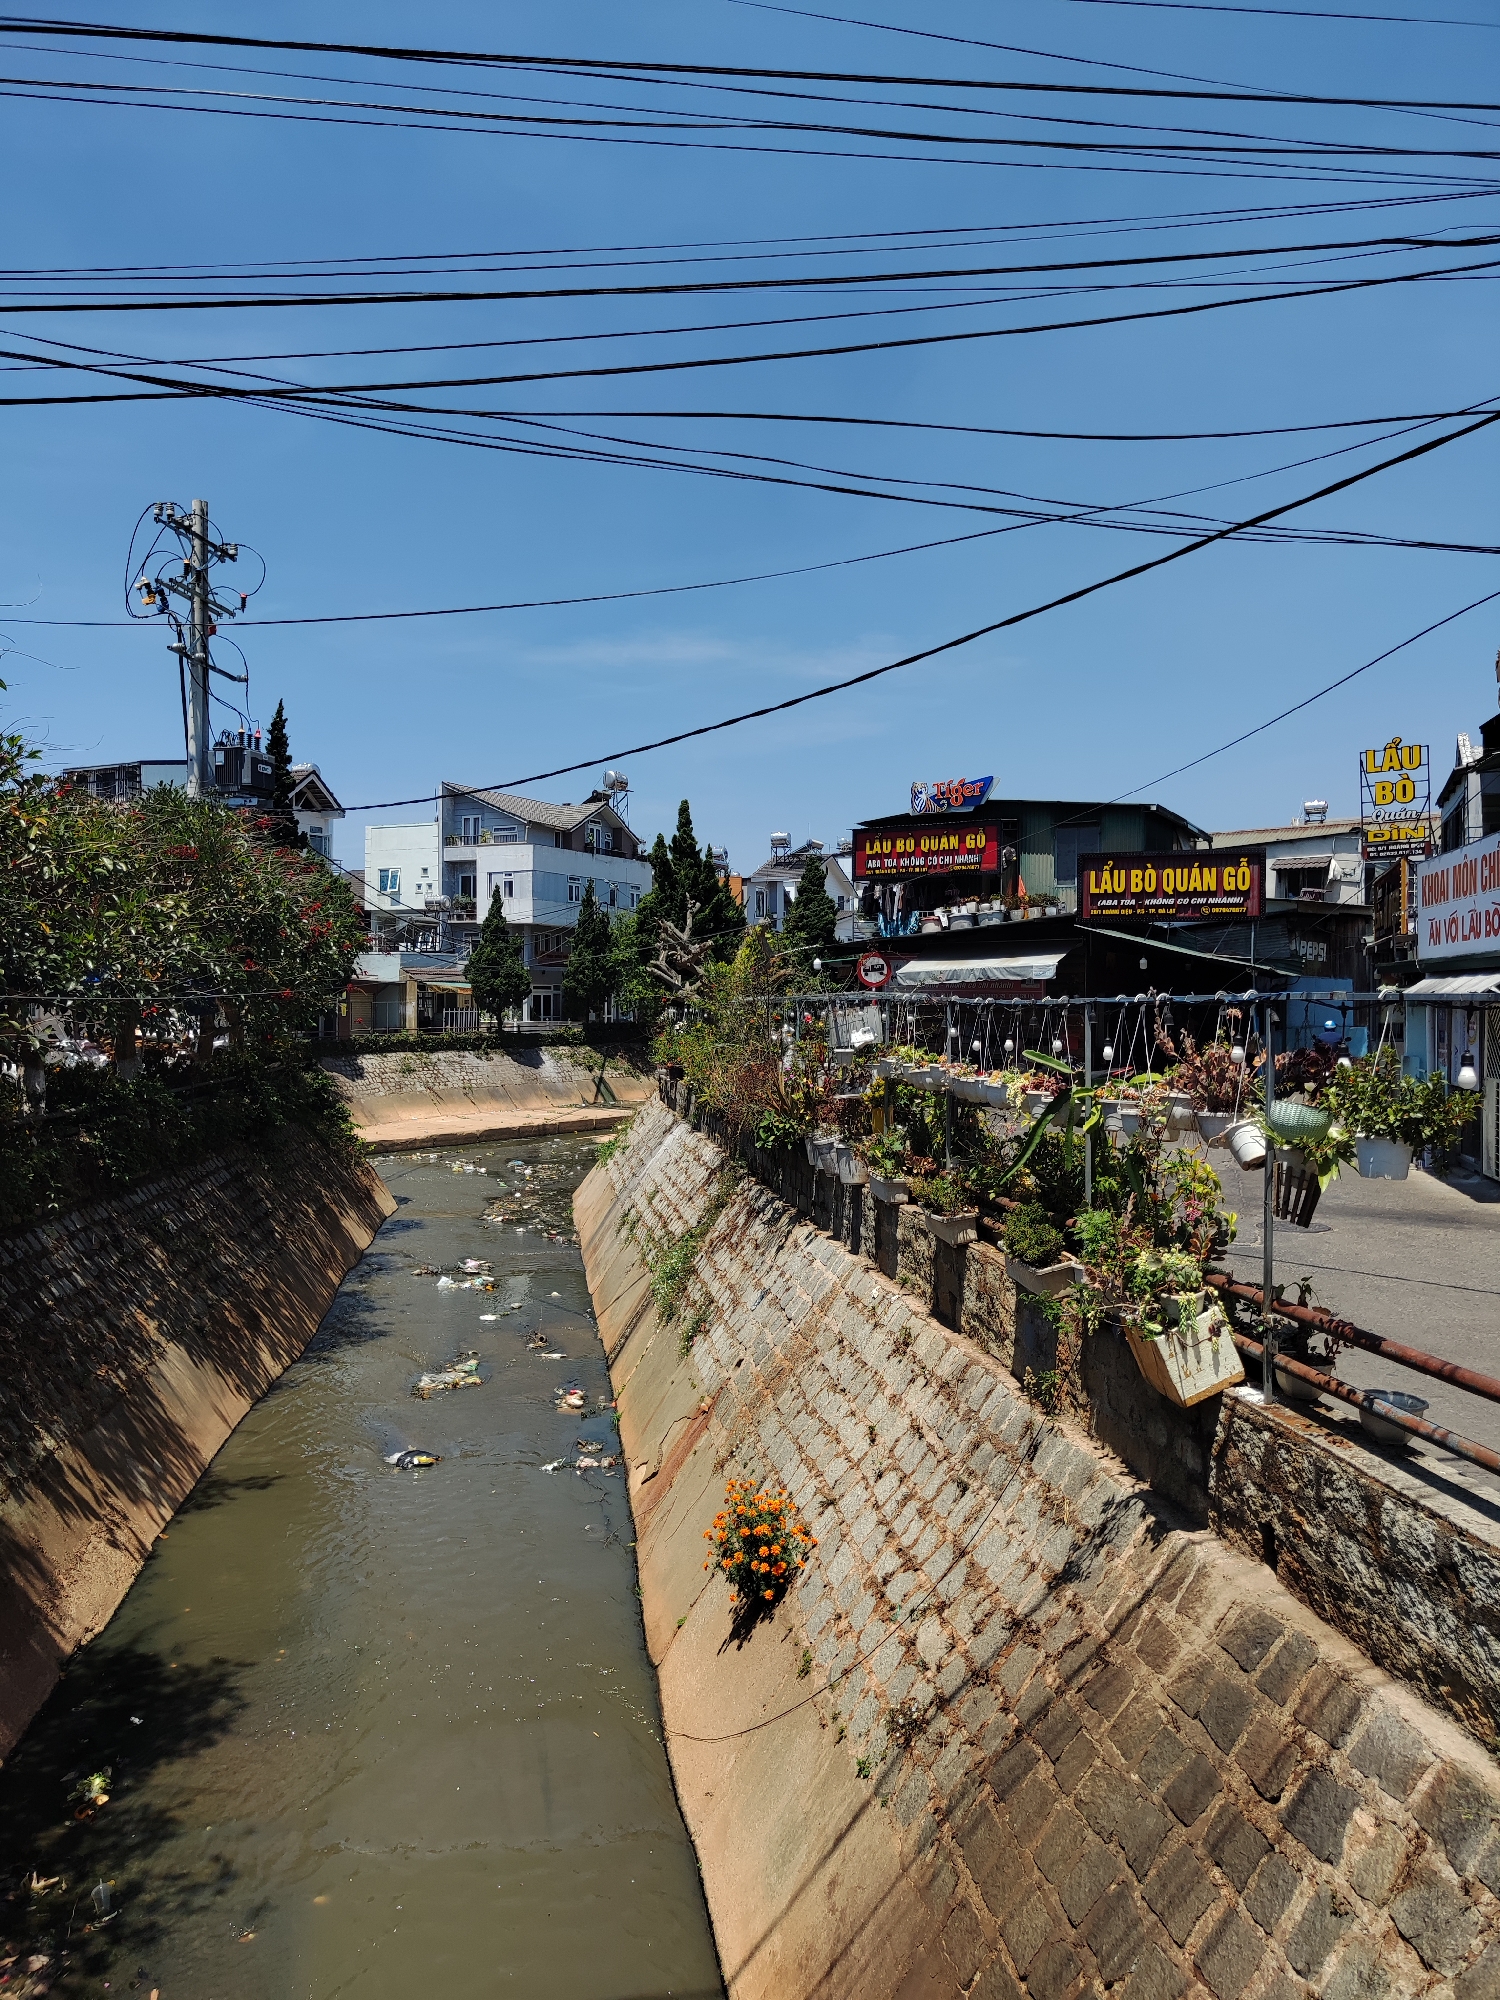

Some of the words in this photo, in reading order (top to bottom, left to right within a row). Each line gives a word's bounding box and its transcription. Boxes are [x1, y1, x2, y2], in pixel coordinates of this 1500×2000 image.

[1365, 736, 1422, 774] LẨU
[932, 777, 985, 807] Tiger
[1374, 773, 1416, 806] BÒ
[1372, 807, 1420, 824] Quán
[865, 832, 892, 855] LẨU
[896, 832, 915, 853] BÒ
[920, 830, 959, 853] QUÁN
[965, 827, 986, 849] GỖ
[884, 857, 898, 868] TOA
[900, 855, 925, 867] KHÔNG
[927, 854, 938, 865] CÓ
[939, 855, 953, 865] CHI
[1089, 860, 1127, 894] LẨU
[1130, 863, 1157, 893] BÒ
[1162, 862, 1218, 895] QUÁN
[1223, 857, 1251, 892] GỖ
[1421, 867, 1450, 909] KHOAI
[1452, 853, 1478, 900] MÔN
[1097, 899, 1119, 907] (ABA
[1120, 898, 1136, 906] TOA
[1144, 897, 1175, 906] KHÔNG
[1177, 896, 1189, 905] CÓ
[1191, 897, 1207, 905] CHI
[1208, 896, 1244, 905] NHÁNH)
[1427, 917, 1442, 947] ĂN
[1444, 909, 1459, 945] VỚI
[1484, 901, 1500, 938] BÒ
